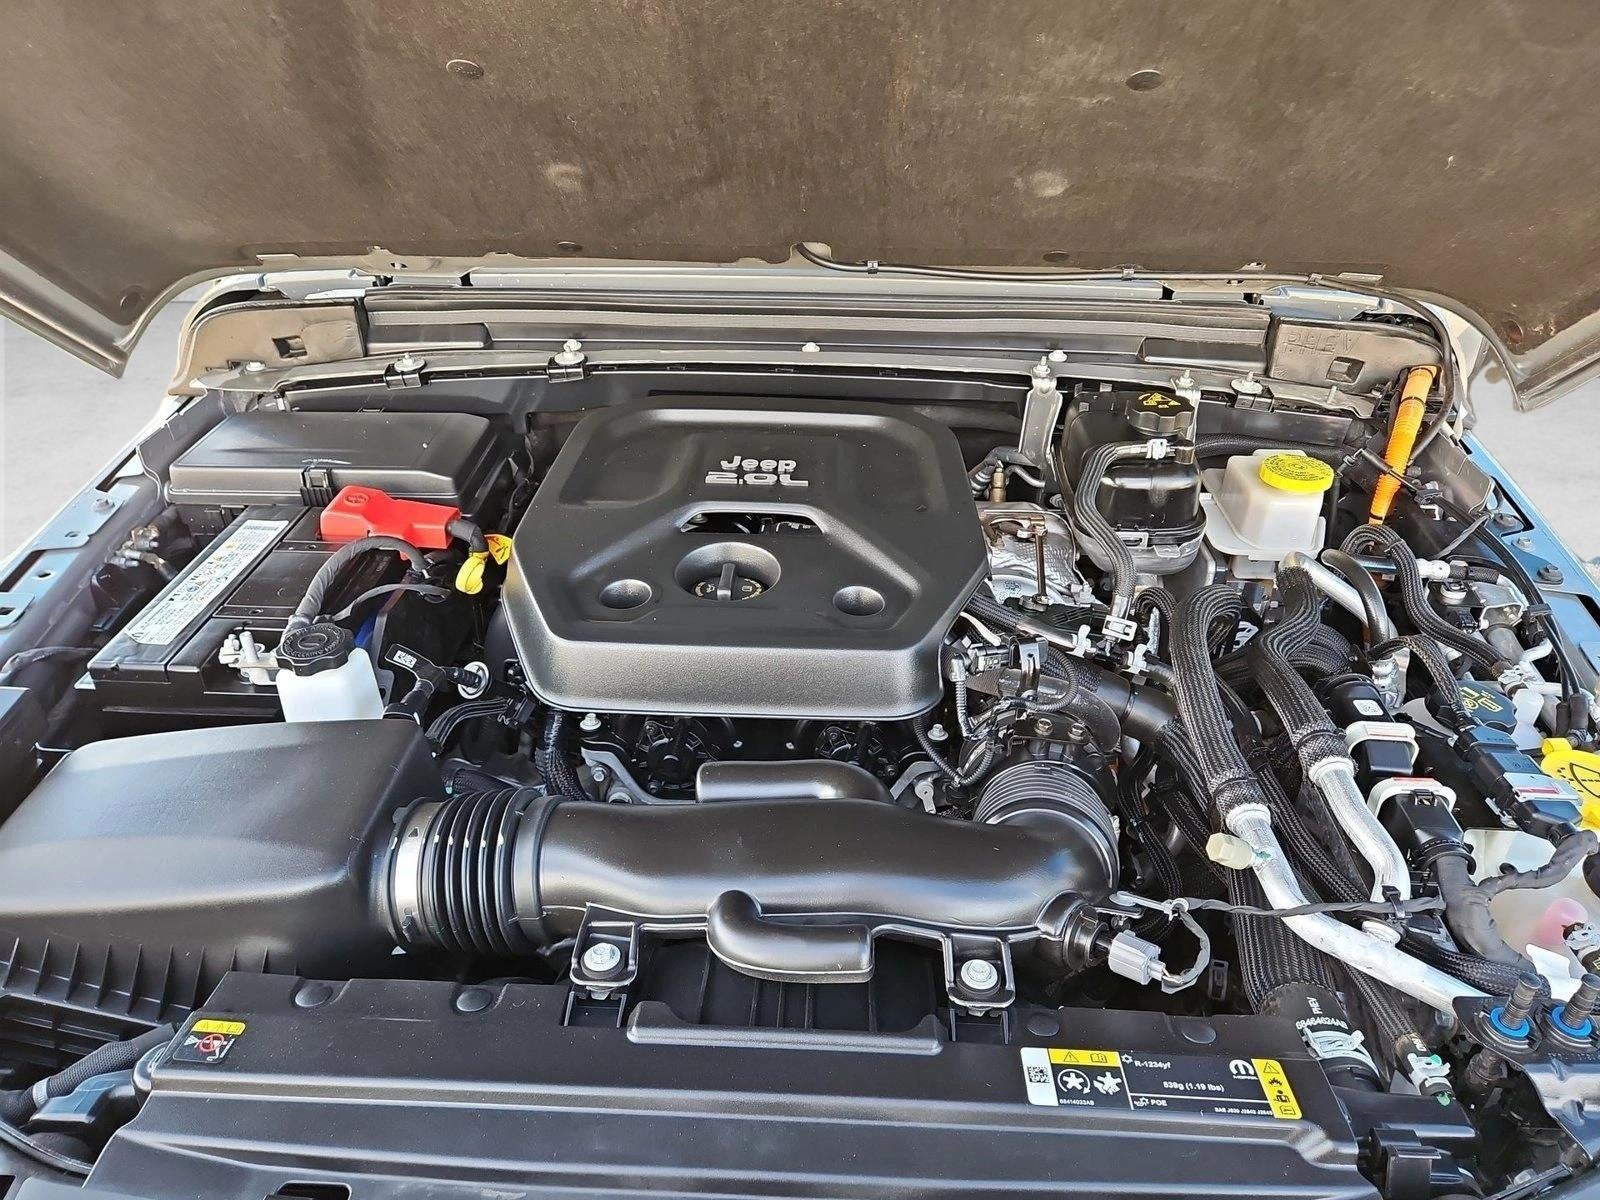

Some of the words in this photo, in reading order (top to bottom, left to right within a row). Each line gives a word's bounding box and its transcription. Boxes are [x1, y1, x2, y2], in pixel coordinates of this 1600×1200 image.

[720, 455, 797, 474] Jeep
[705, 471, 809, 487] 2.0L
[1150, 1099, 1168, 1107] POE
